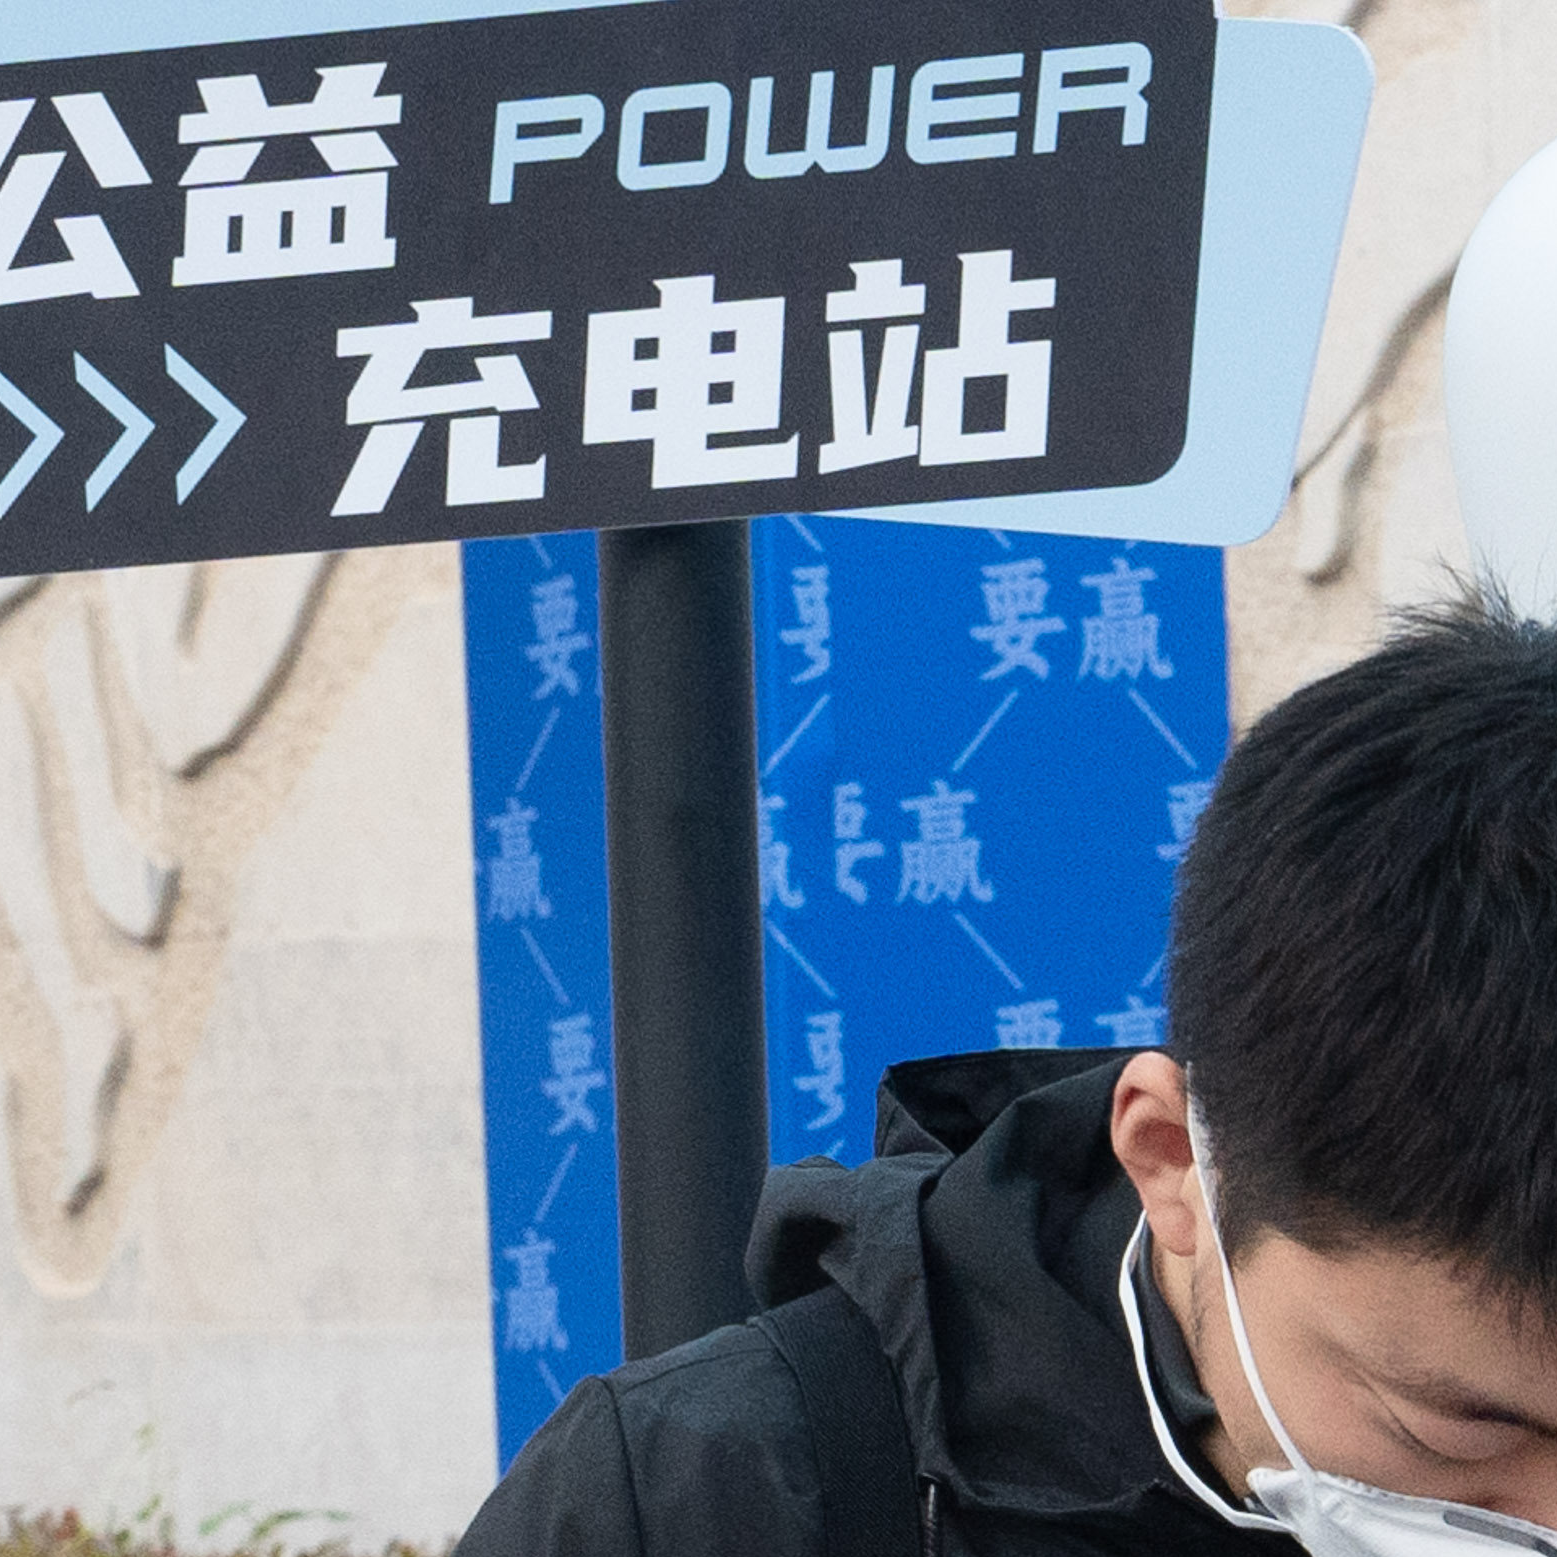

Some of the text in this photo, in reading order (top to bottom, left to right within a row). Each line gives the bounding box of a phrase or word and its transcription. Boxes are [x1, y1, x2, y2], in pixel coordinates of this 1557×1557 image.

[488, 41, 1152, 204] POWER
[330, 248, 1057, 517] 充电站
[969, 556, 1173, 682] 要赢
